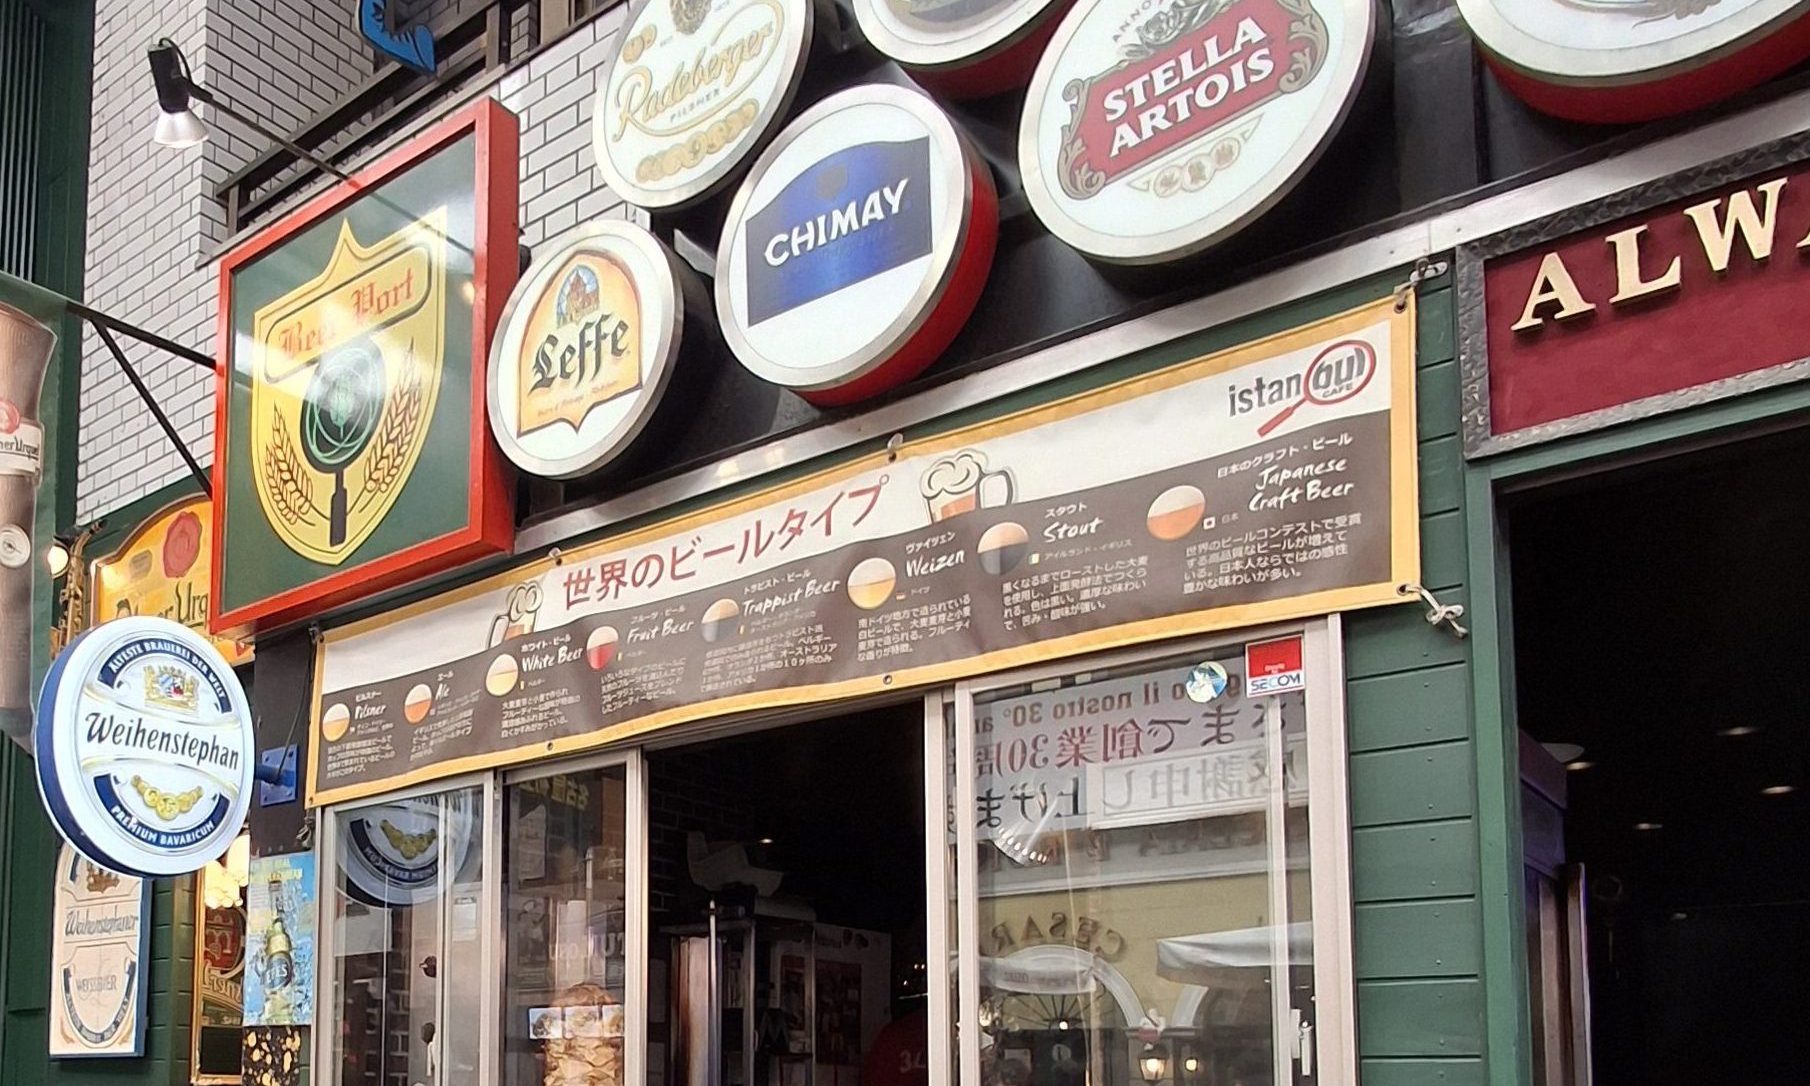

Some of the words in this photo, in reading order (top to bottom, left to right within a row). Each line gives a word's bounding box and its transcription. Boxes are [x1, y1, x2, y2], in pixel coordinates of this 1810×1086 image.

[612, 21, 774, 142] Radeberger
[1103, 17, 1266, 121] STELLA
[1109, 47, 1274, 158] ARTOIS
[764, 178, 908, 266] CHIMAY
[1510, 177, 1810, 331] ALW
[528, 312, 629, 395] Leffe
[1217, 432, 1353, 479] 日本のクラフト・ビール
[1254, 456, 1348, 490] Japanese
[1044, 502, 1087, 519] スタウト
[1249, 487, 1303, 512] Craft
[1306, 480, 1354, 501] Beer
[563, 474, 889, 610] 世界のビールタイプ
[1043, 517, 1104, 543] Stout
[906, 549, 965, 577] Weizen
[742, 588, 803, 616] Trappist
[804, 579, 840, 598] Beer
[627, 626, 658, 645] Fruit
[661, 618, 694, 637] Beer
[521, 654, 554, 673] White
[557, 646, 583, 665] Beer
[435, 683, 450, 700] Ale
[1251, 673, 1301, 691] SECOM
[354, 703, 387, 720] Pilsner
[84, 712, 239, 770] Weihenstephan
[111, 805, 157, 844] PREMIUM
[160, 820, 215, 846] BAVARICUM
